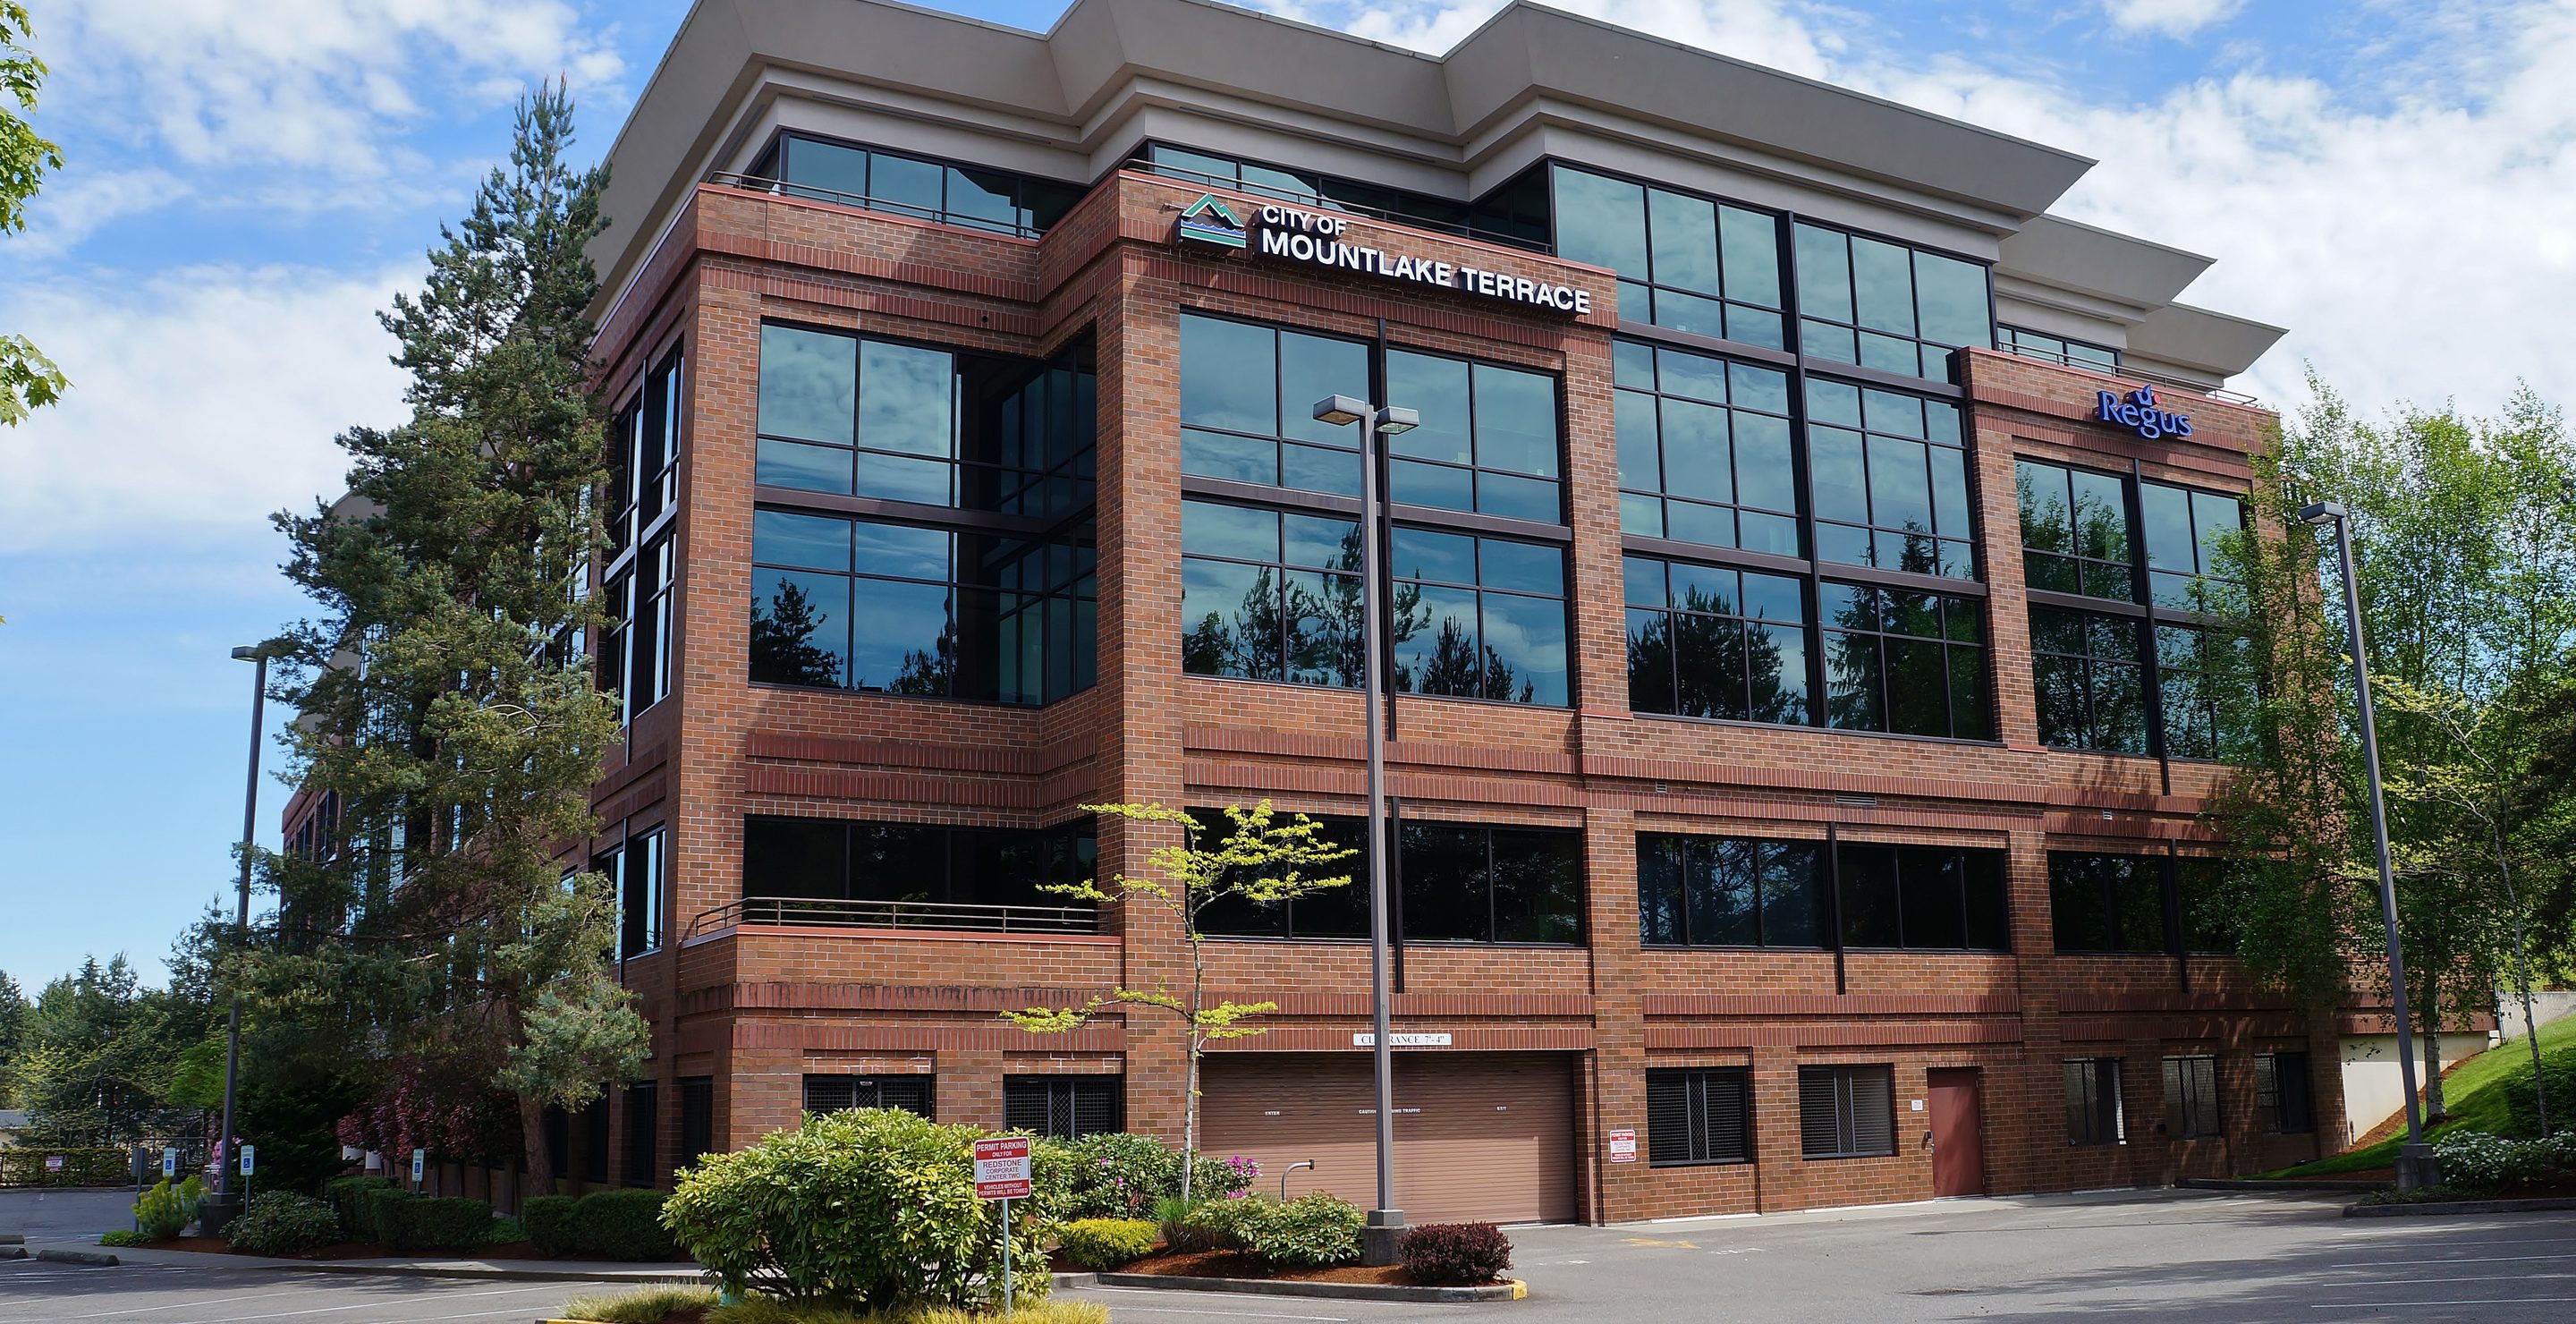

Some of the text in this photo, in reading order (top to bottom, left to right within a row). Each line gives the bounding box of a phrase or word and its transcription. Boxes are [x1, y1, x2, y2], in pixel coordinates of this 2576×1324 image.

[1262, 205, 1347, 235] CITY OF
[1262, 228, 1591, 314] MOUNTLAKE TERRACE
[2097, 391, 2192, 439] Regus
[1361, 1035, 1419, 1044] CLRANCE
[977, 1142, 1026, 1151] PERMIT PARKING
[983, 1159, 1021, 1167] REDSTONE
